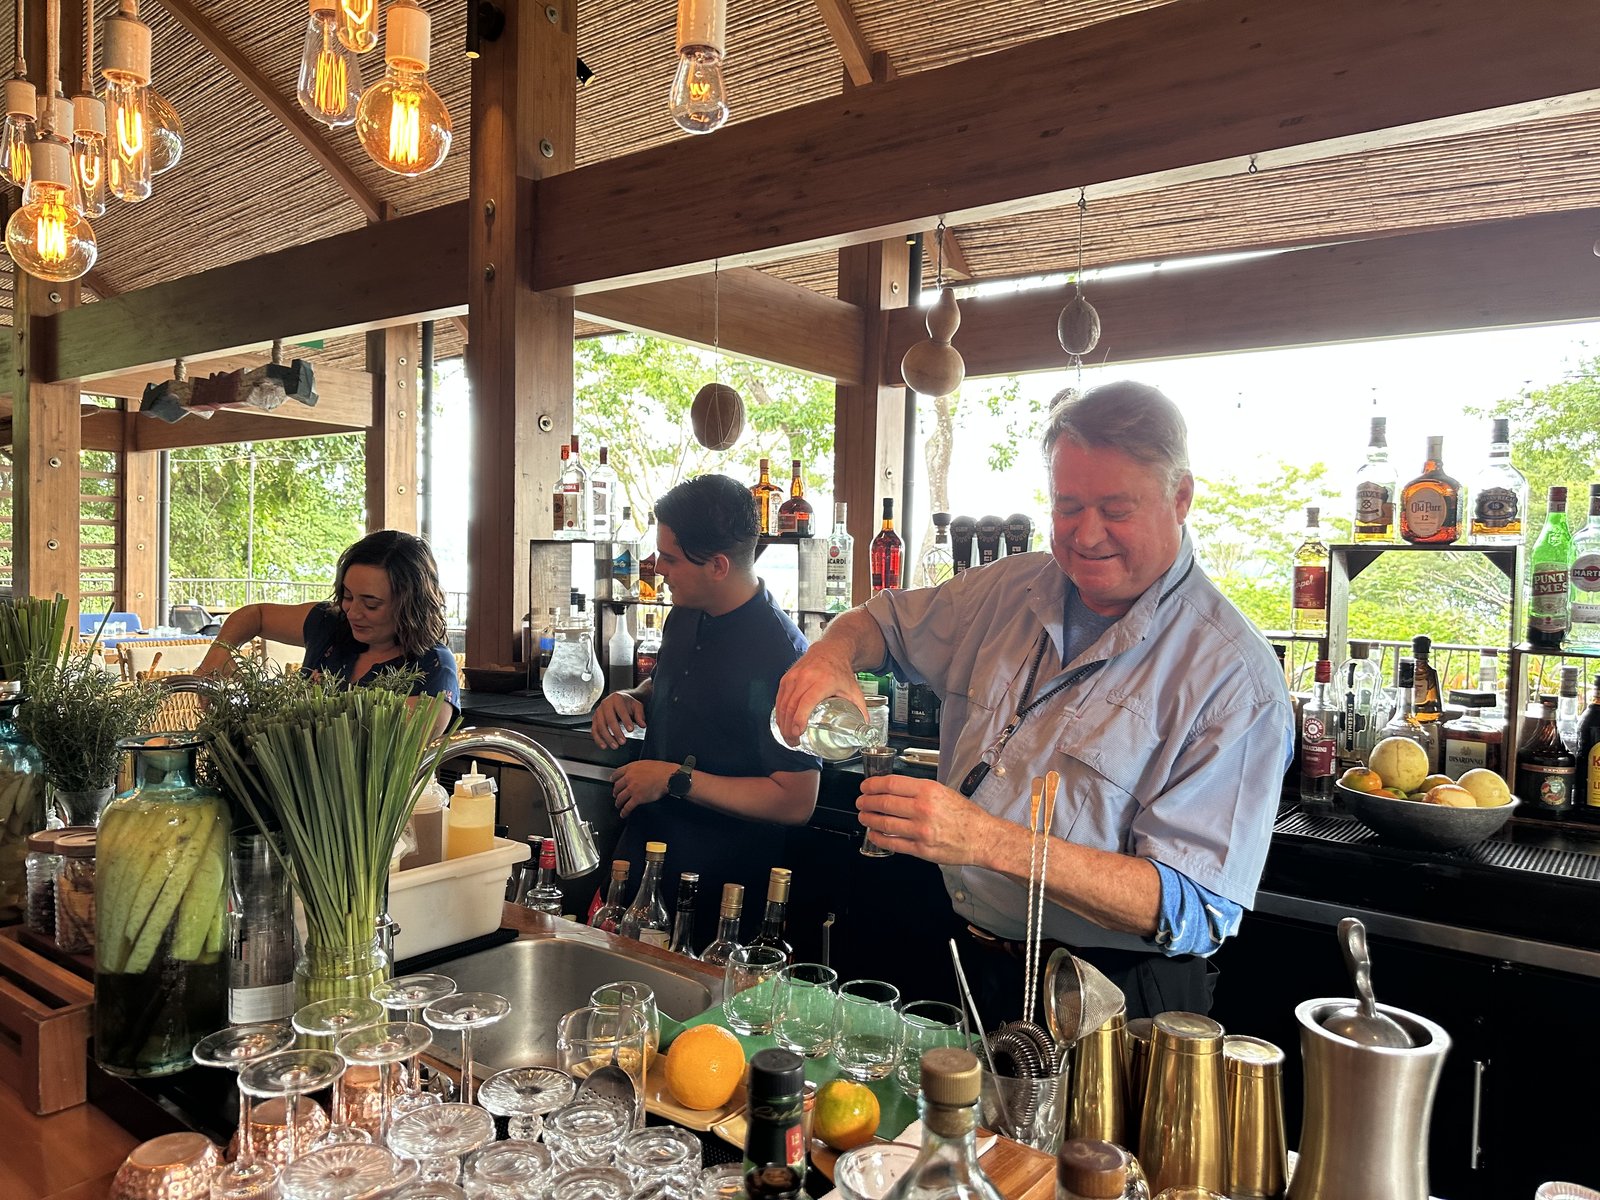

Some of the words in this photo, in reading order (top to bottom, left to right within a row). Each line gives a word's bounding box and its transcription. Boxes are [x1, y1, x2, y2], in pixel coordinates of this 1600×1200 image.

[1411, 500, 1425, 514] Old
[1425, 501, 1441, 513] Parr
[1533, 572, 1565, 584] PUNT
[1448, 755, 1484, 765] DISARONNO
